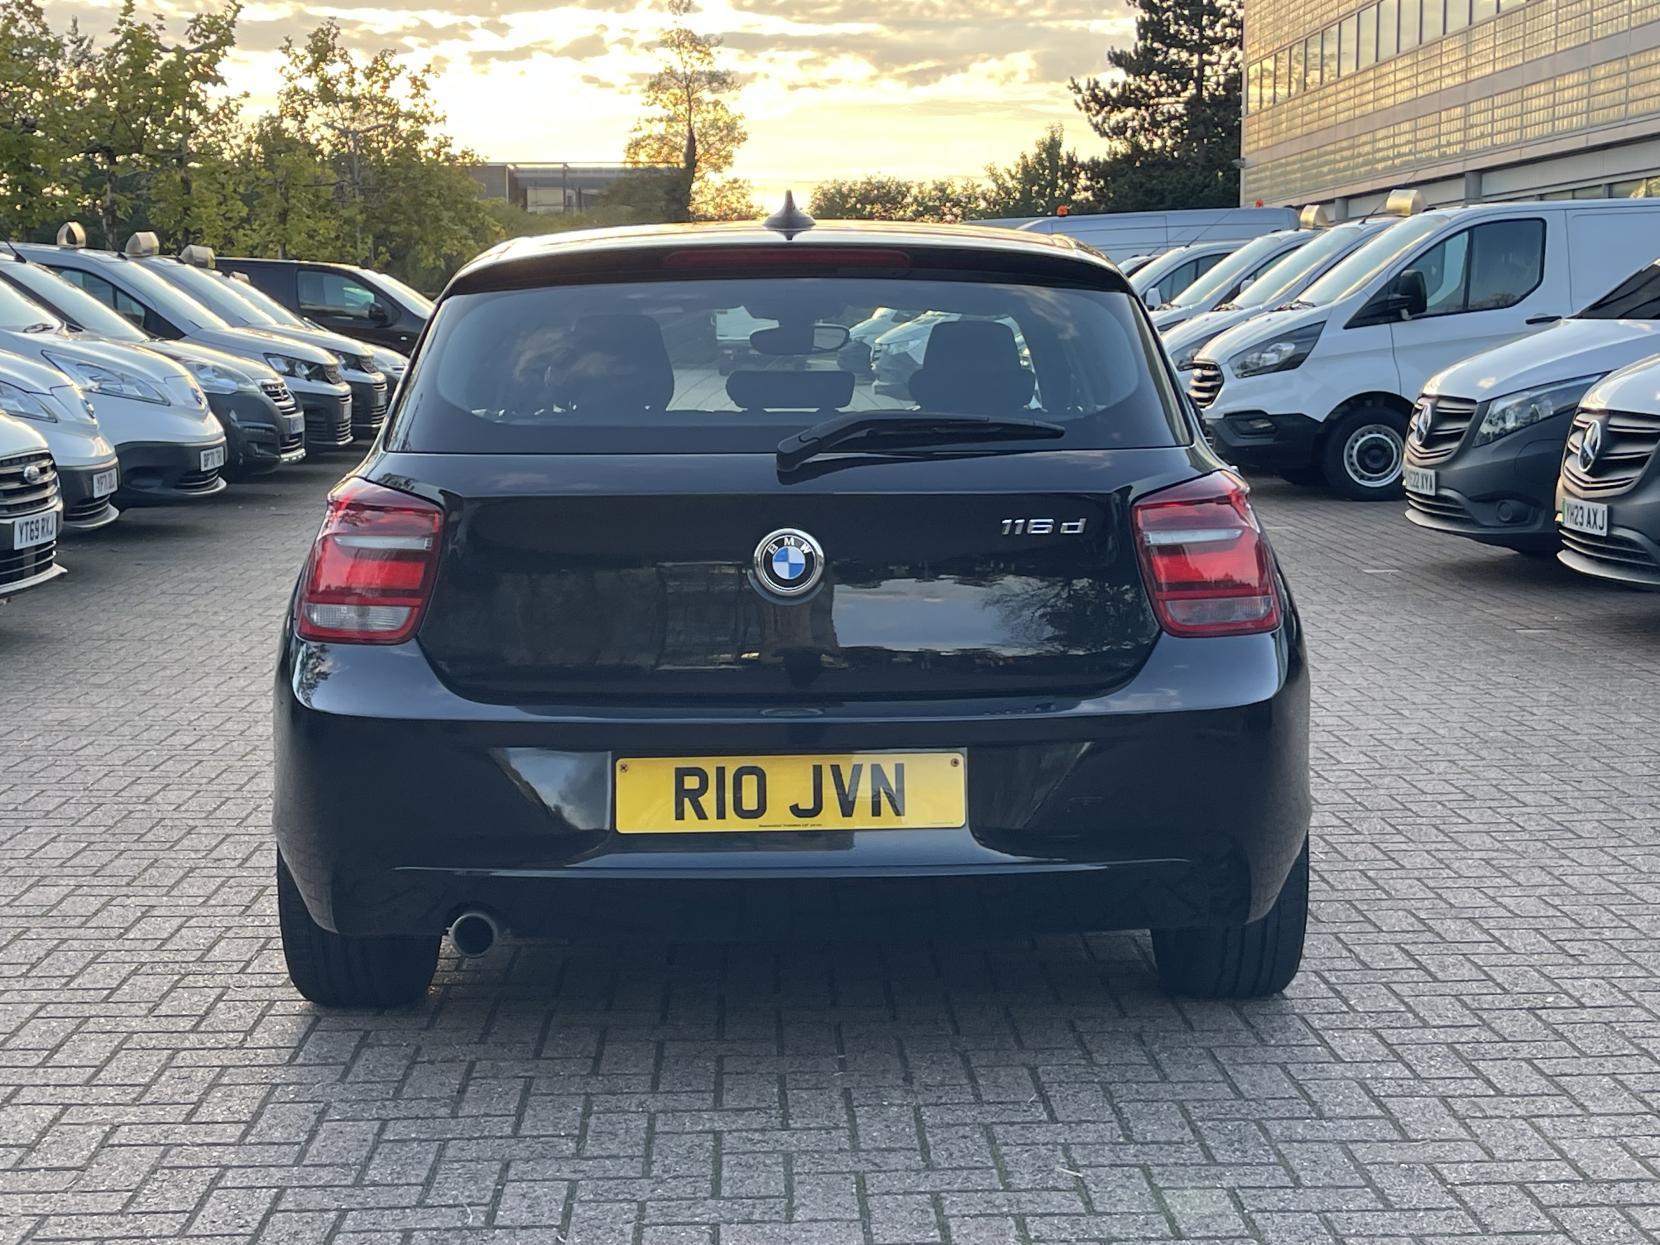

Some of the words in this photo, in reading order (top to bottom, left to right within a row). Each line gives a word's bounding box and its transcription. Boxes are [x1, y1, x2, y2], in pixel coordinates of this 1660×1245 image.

[1586, 507, 1605, 531] AXJ
[19, 519, 40, 544] YT69
[767, 537, 812, 555] BMW
[789, 762, 906, 819] JVN
